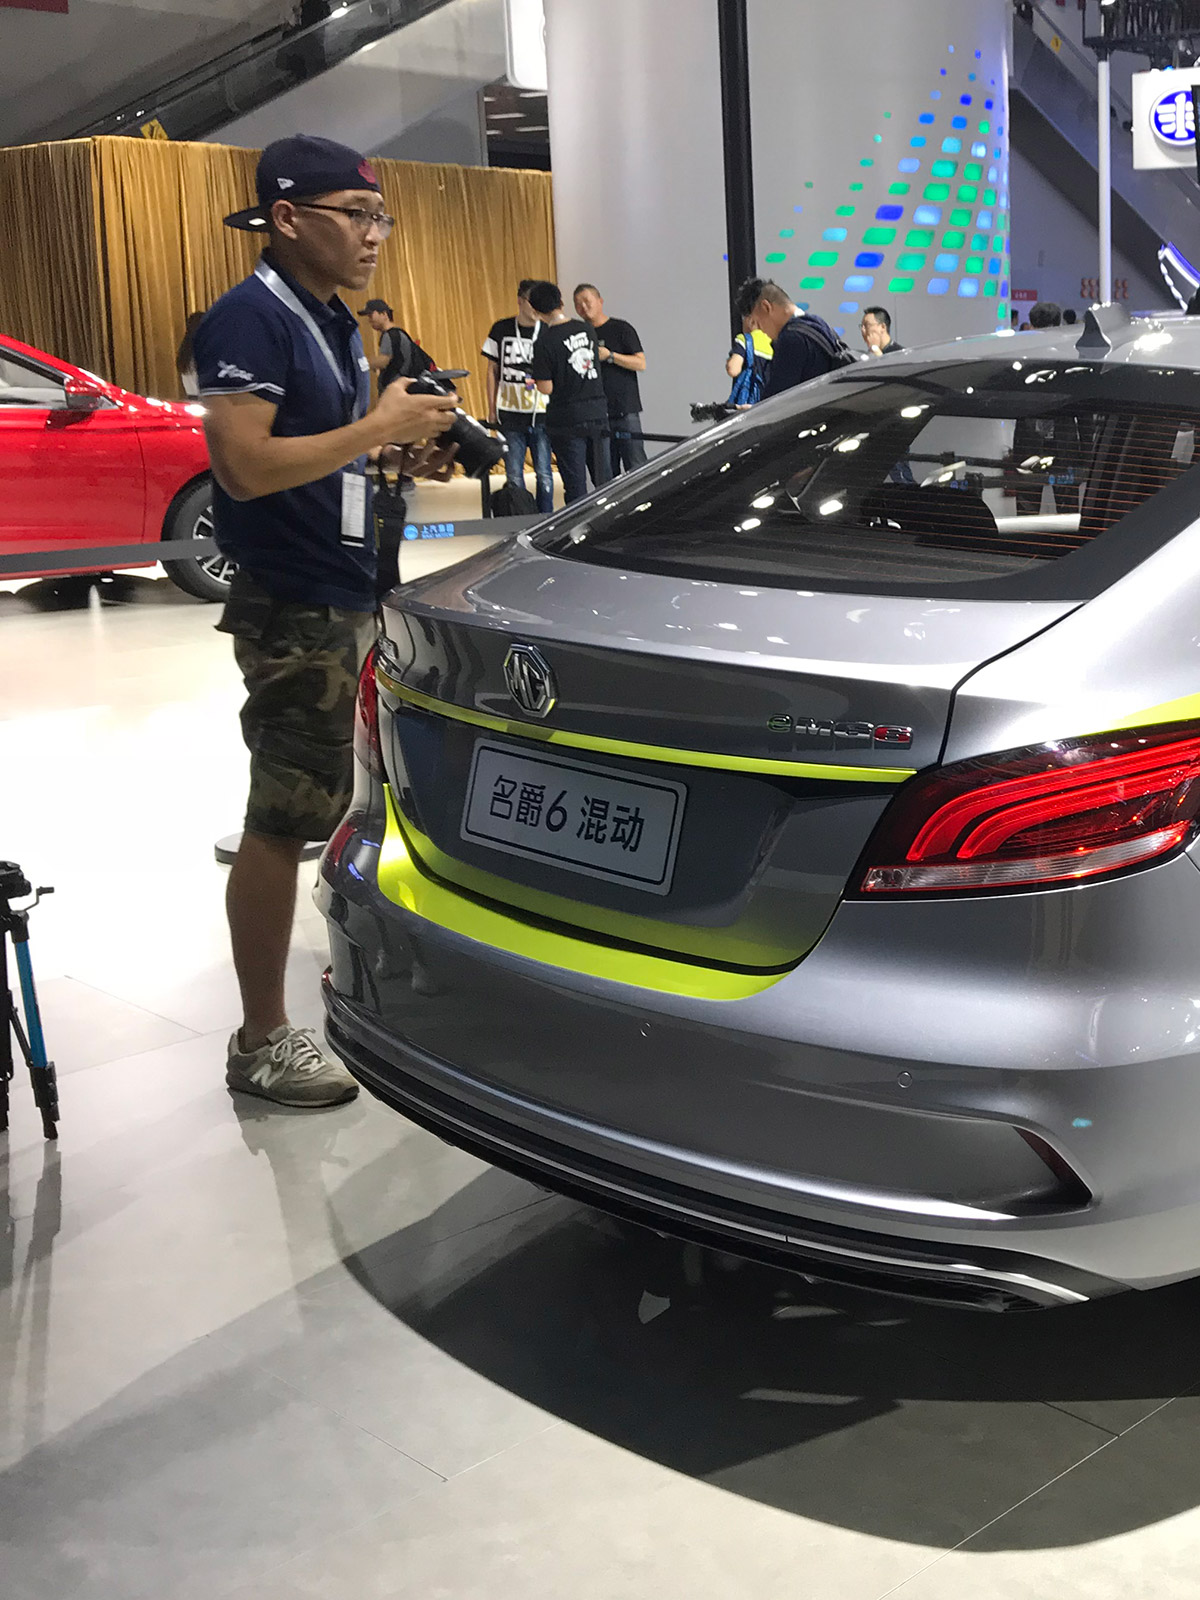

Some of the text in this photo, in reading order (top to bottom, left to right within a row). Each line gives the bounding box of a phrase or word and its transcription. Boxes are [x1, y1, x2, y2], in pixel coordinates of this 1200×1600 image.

[506, 648, 553, 714] MG
[489, 775, 645, 852] 名爵6 混动
